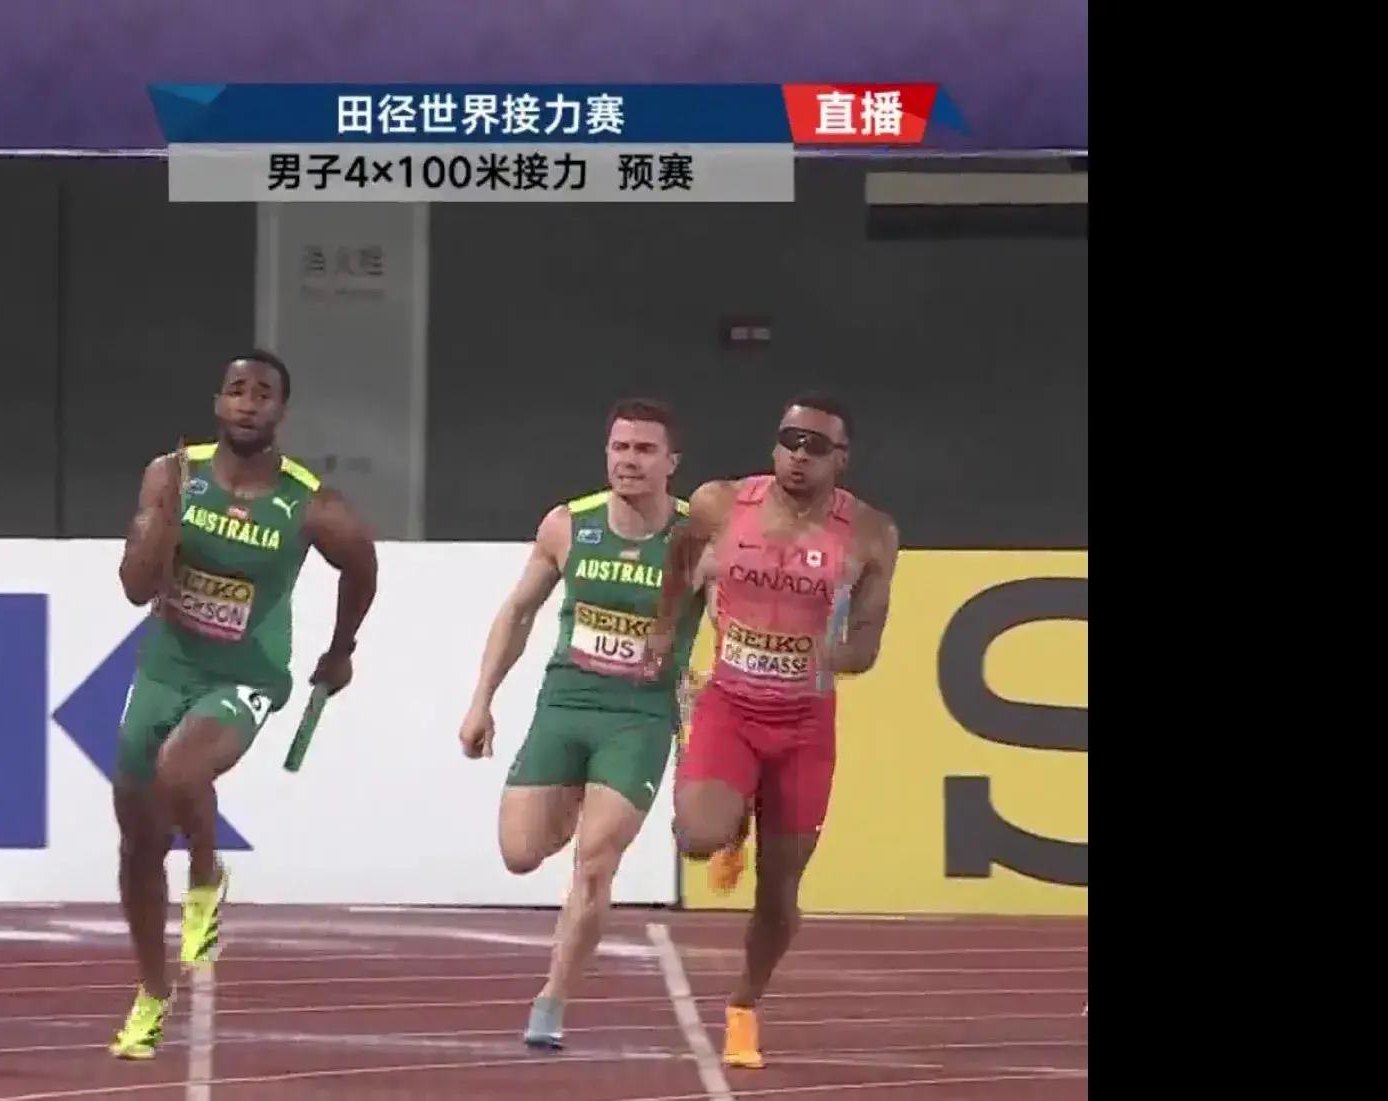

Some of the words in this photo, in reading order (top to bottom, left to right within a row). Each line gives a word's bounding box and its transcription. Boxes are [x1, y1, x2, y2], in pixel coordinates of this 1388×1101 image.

[181, 505, 281, 551] AUSTRALIA
[182, 572, 252, 603] EIKO
[575, 559, 663, 588] AUSTRALI
[729, 564, 830, 602] CANADA
[181, 593, 246, 627] CKSON
[594, 634, 635, 660] IUS
[727, 621, 813, 654] SEIKO
